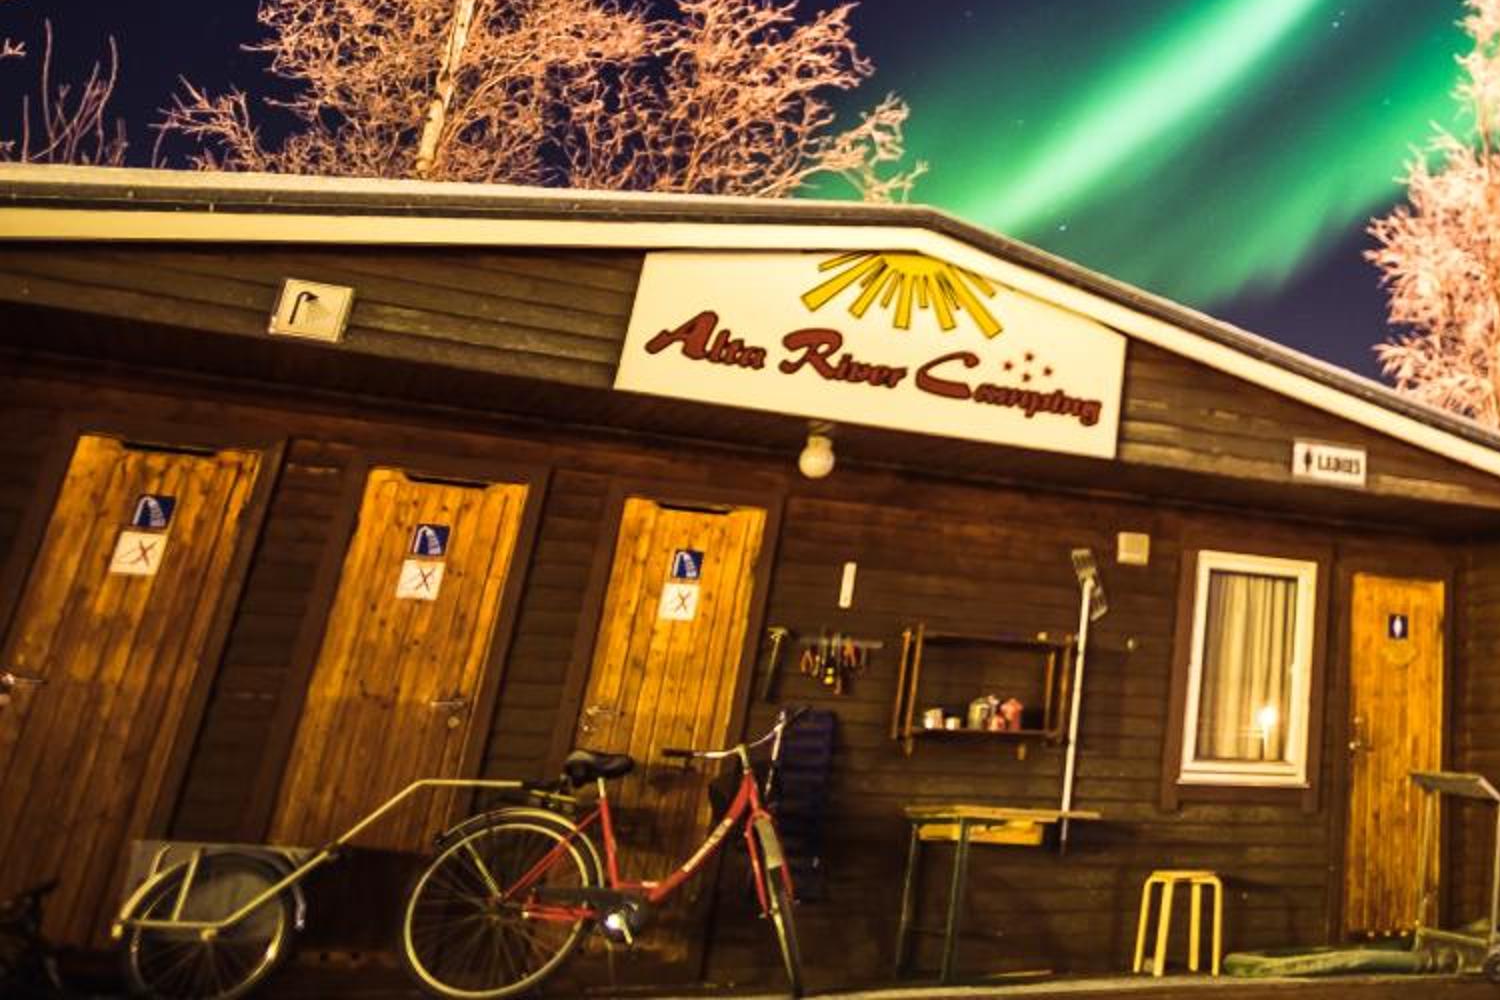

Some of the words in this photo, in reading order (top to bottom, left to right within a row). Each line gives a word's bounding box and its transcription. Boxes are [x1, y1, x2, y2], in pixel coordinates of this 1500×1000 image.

[644, 310, 767, 371] Alta
[778, 327, 908, 389] River
[915, 351, 1103, 427] Camping
